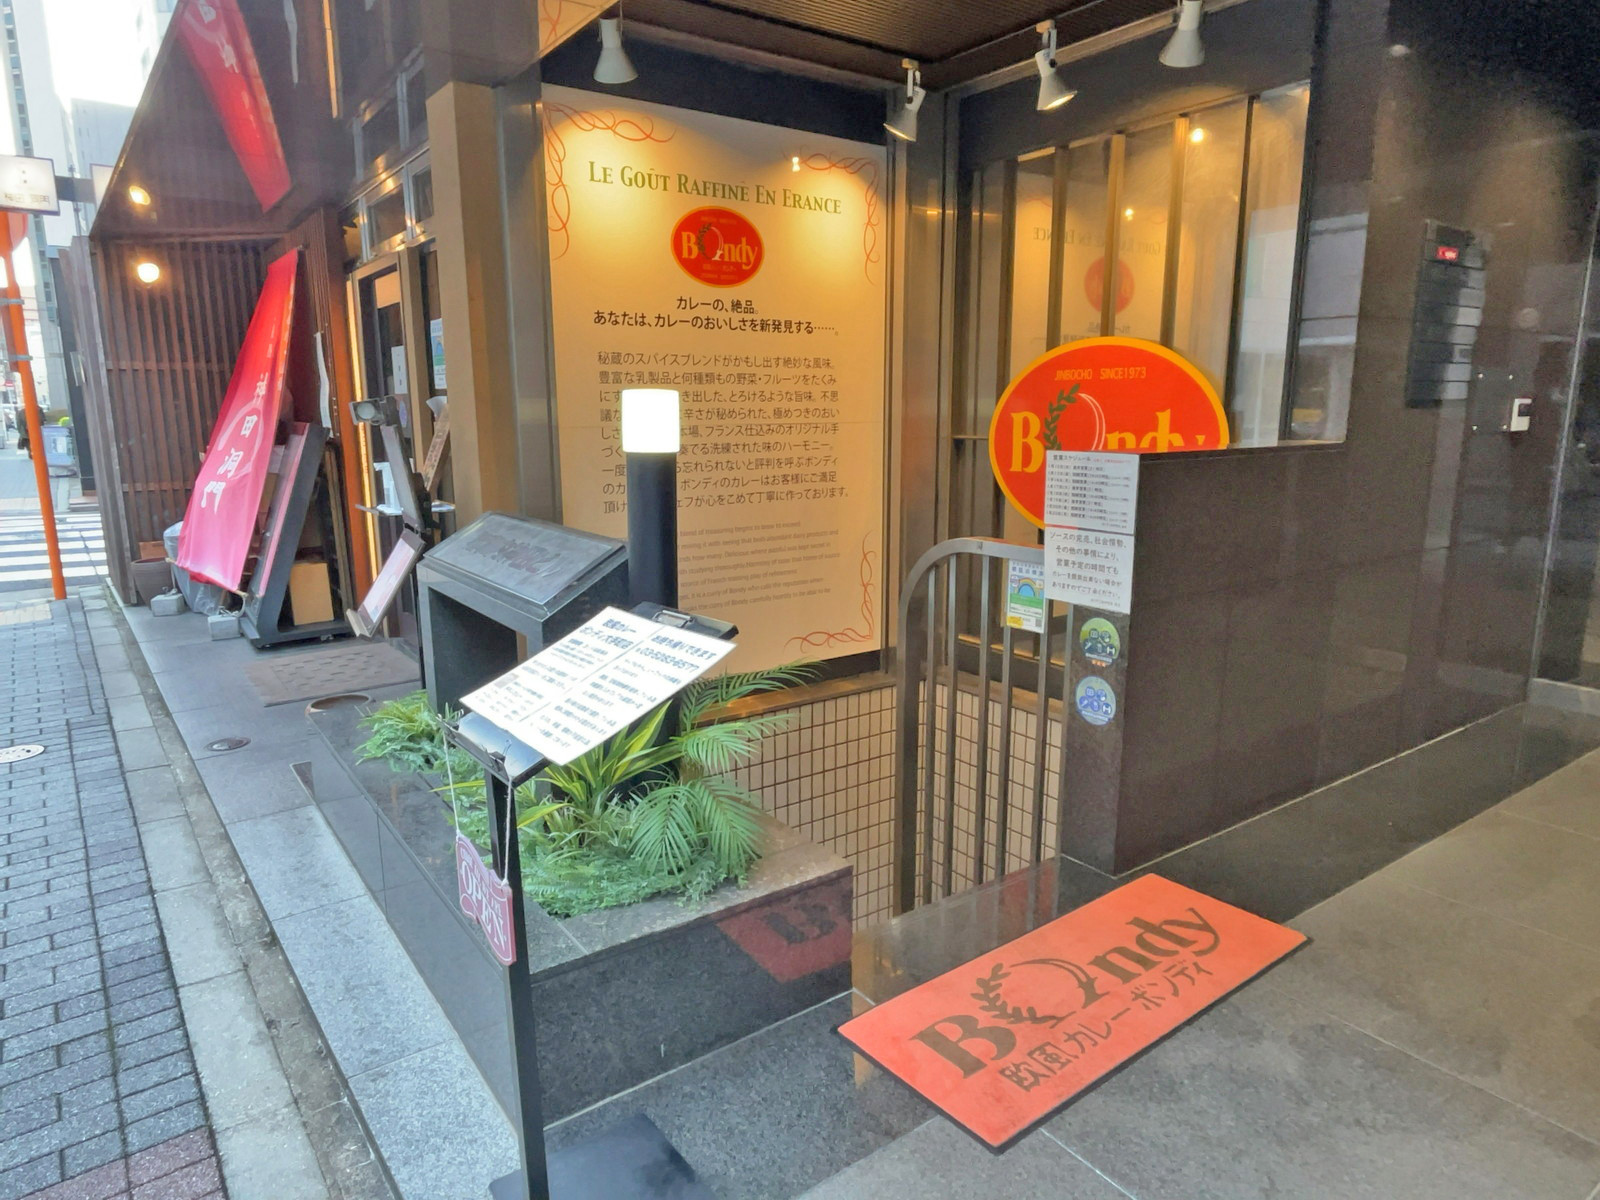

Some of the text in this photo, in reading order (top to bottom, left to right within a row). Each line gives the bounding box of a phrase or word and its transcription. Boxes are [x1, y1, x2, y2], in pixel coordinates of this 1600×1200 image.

[589, 160, 613, 184] LE
[755, 184, 776, 205] EN
[676, 296, 759, 315] カレーの、絶品。
[1055, 368, 1093, 381] JINBOCHO
[460, 860, 507, 951] OPEN
